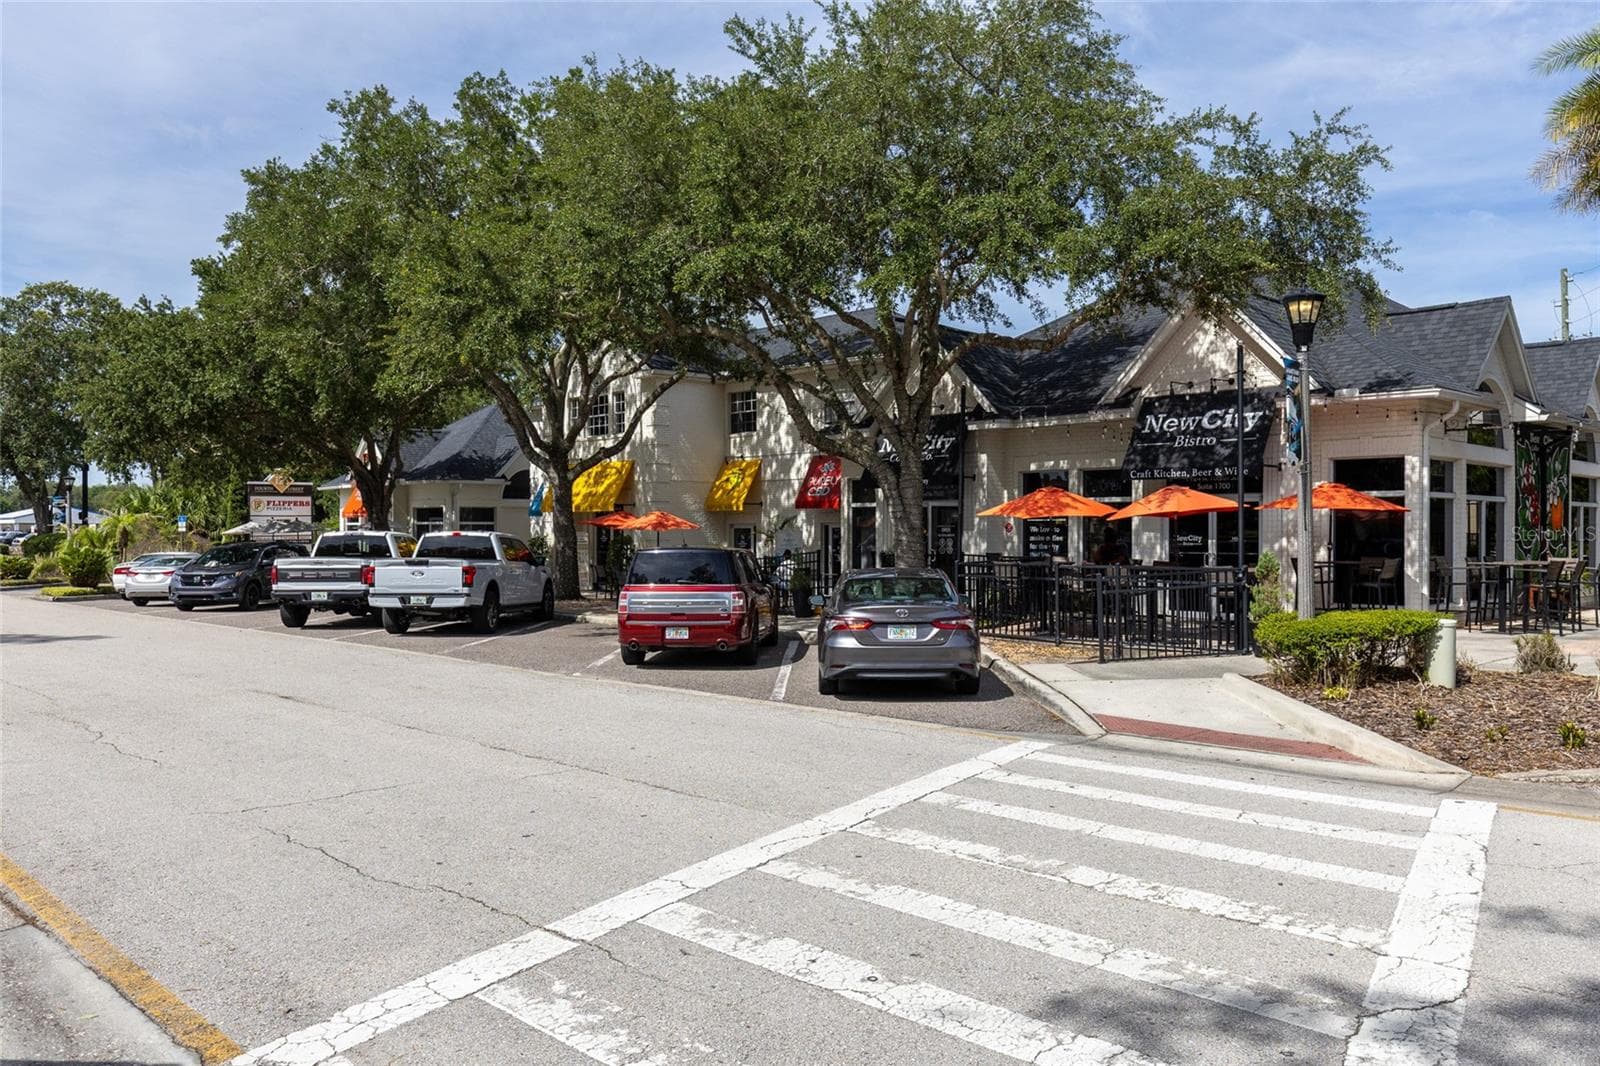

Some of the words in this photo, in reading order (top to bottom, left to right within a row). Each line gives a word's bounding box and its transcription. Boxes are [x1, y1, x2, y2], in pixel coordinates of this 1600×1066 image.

[1173, 435, 1216, 447] Bistro
[1130, 470, 1151, 479] Craft
[1153, 468, 1190, 478] Kitchen,
[1192, 468, 1212, 477] Beer
[1214, 467, 1222, 476] &
[1224, 466, 1249, 476] Wie
